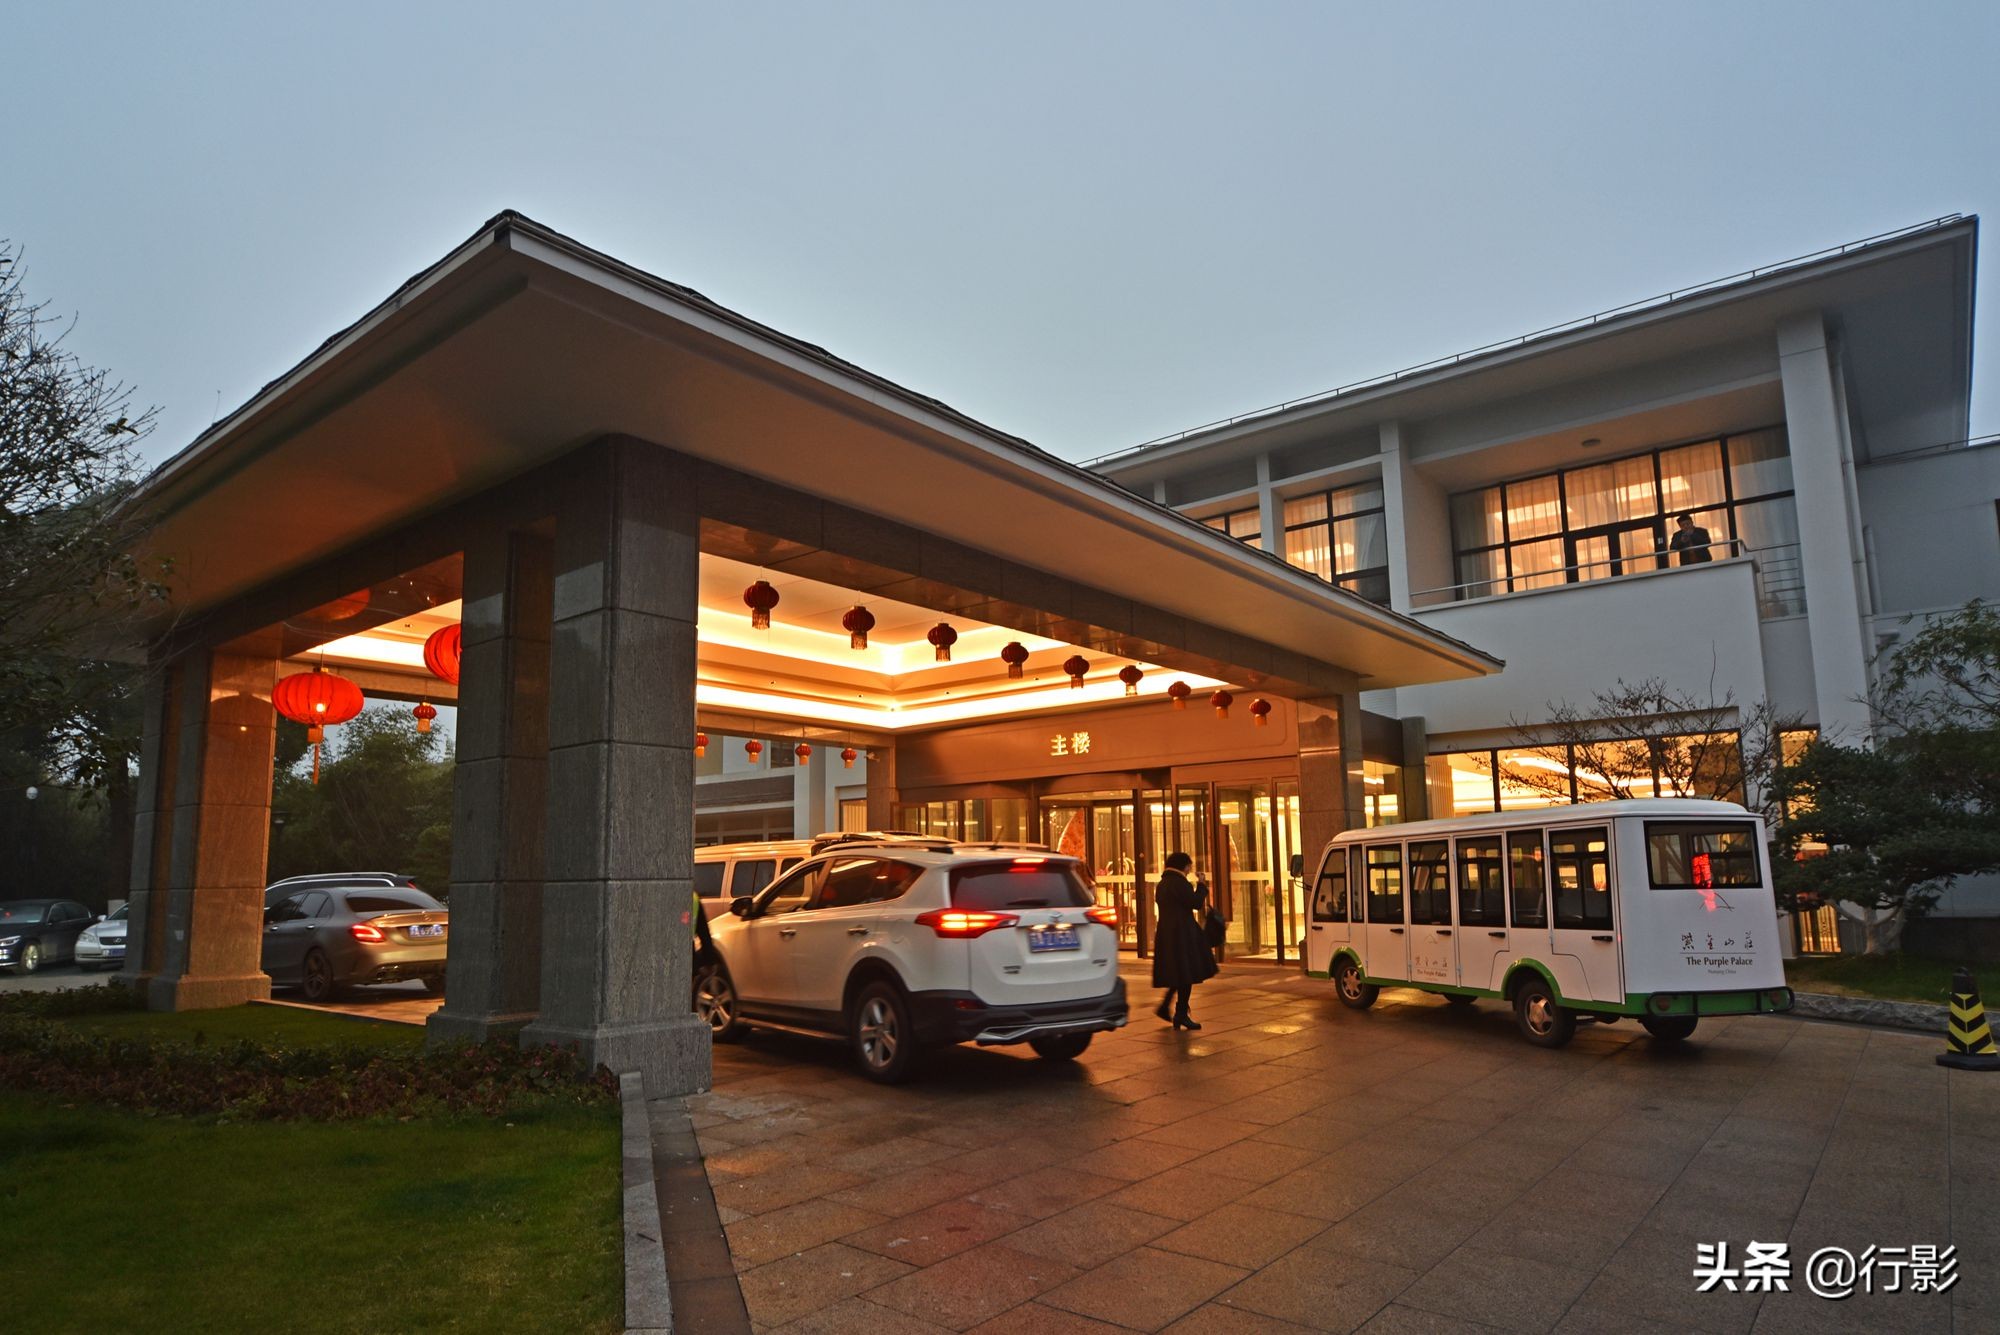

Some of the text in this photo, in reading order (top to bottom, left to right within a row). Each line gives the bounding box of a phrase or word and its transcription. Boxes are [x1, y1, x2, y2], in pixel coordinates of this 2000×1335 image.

[1050, 731, 1090, 756] 主楼
[1686, 956, 1754, 967] The Purple Palace
